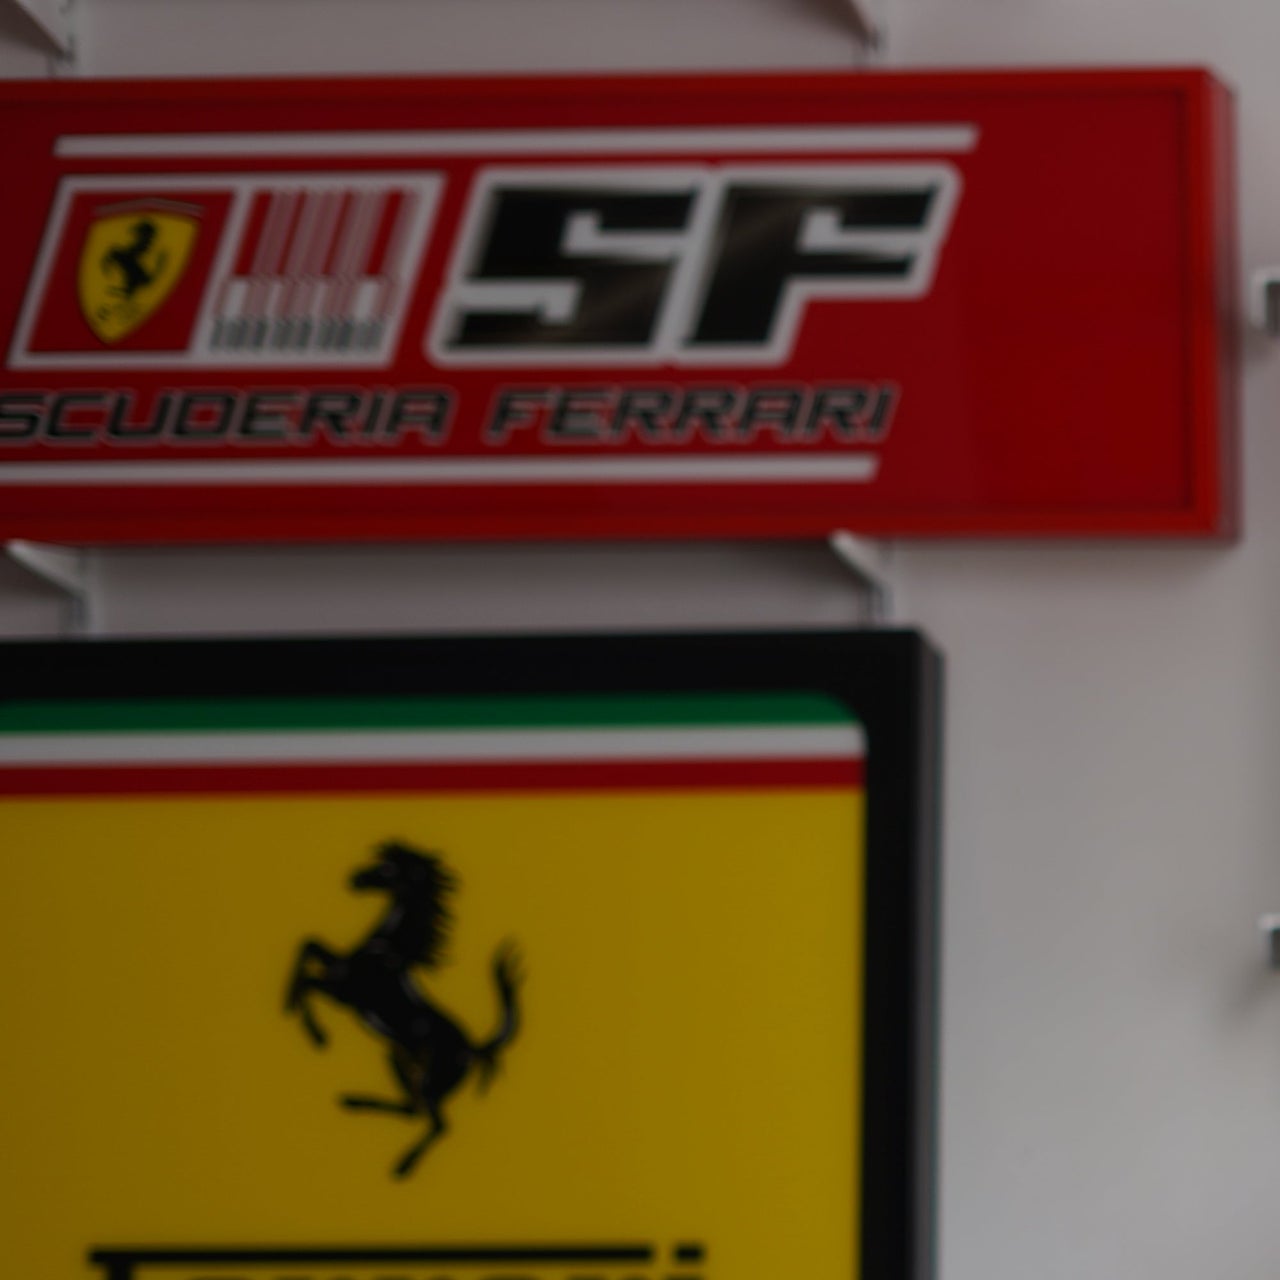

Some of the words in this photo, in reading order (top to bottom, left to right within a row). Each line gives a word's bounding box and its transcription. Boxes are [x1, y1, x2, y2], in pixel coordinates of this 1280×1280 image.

[432, 168, 957, 360] SF
[0, 388, 455, 444] SCUDERIA
[484, 384, 898, 443] FERRARI
